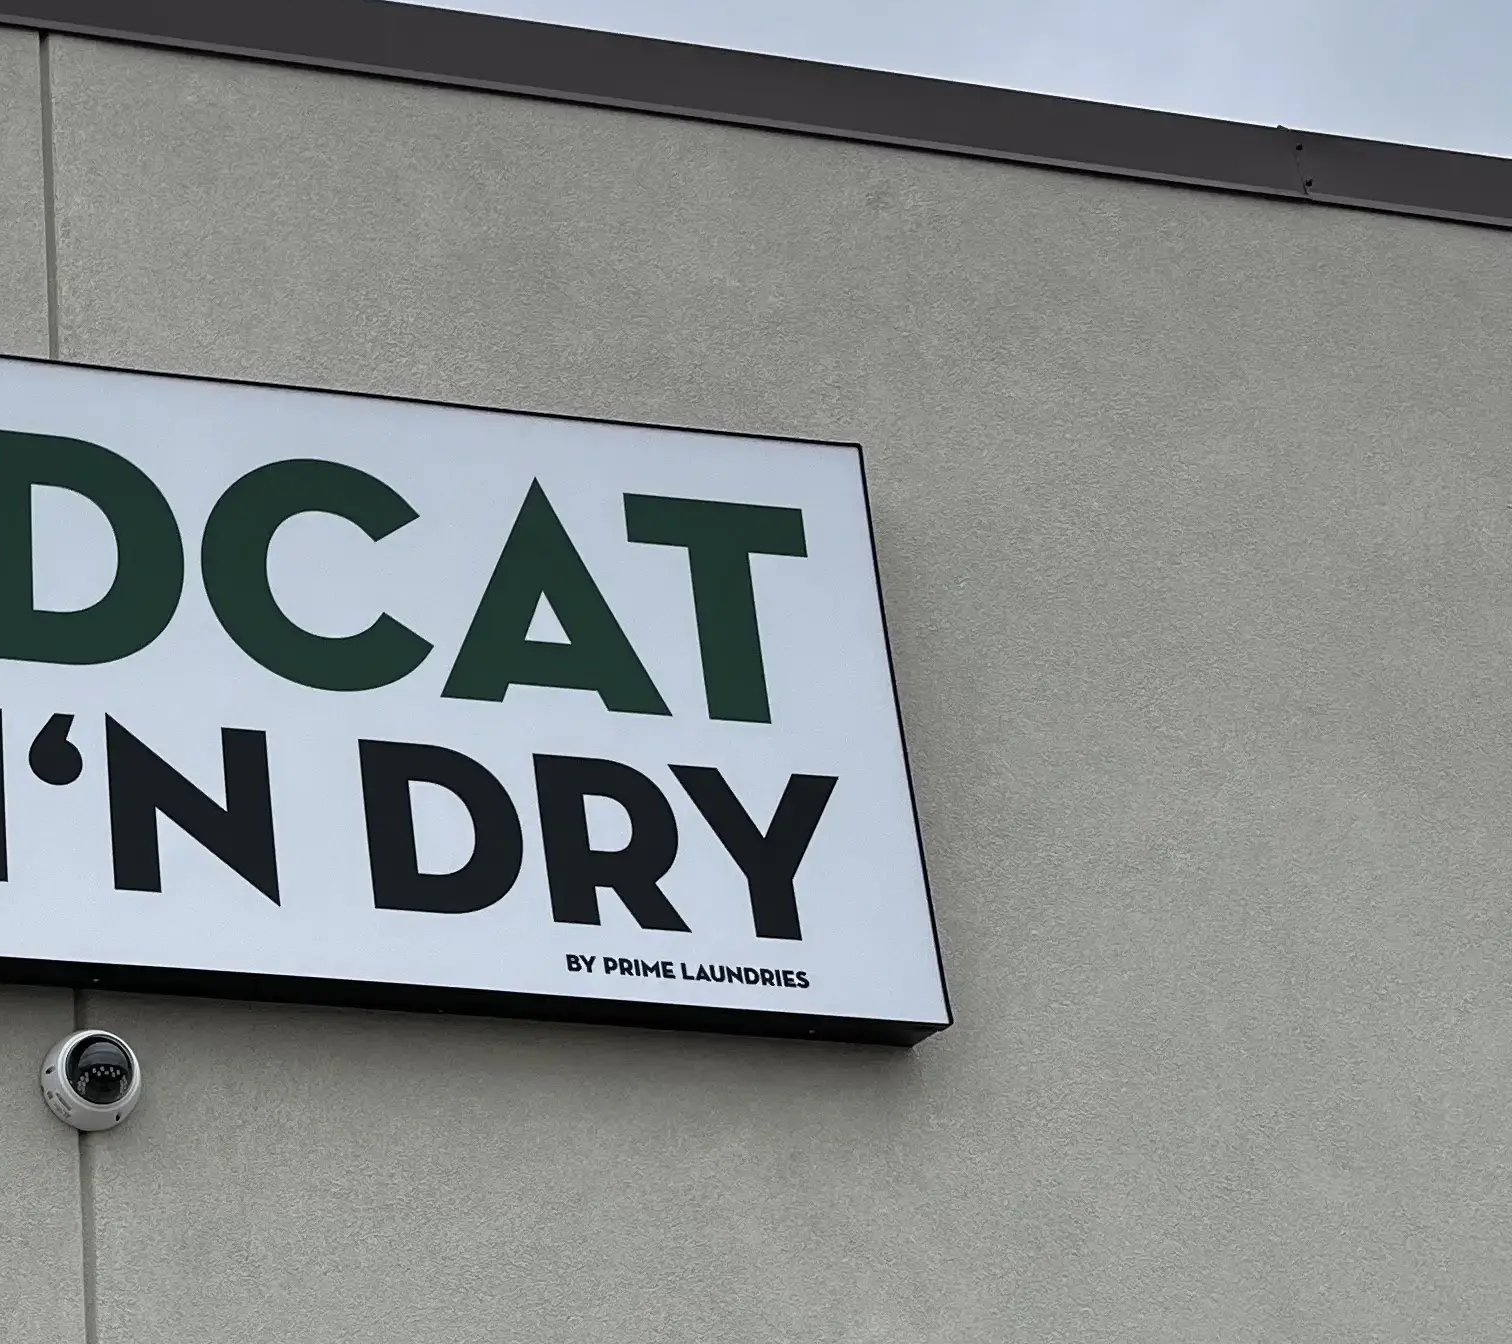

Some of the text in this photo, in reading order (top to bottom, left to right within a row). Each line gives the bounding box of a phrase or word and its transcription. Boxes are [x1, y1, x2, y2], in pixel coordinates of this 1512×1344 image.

[358, 739, 838, 941] DRY
[565, 953, 810, 989] BY PRIME LAUNDRIES
